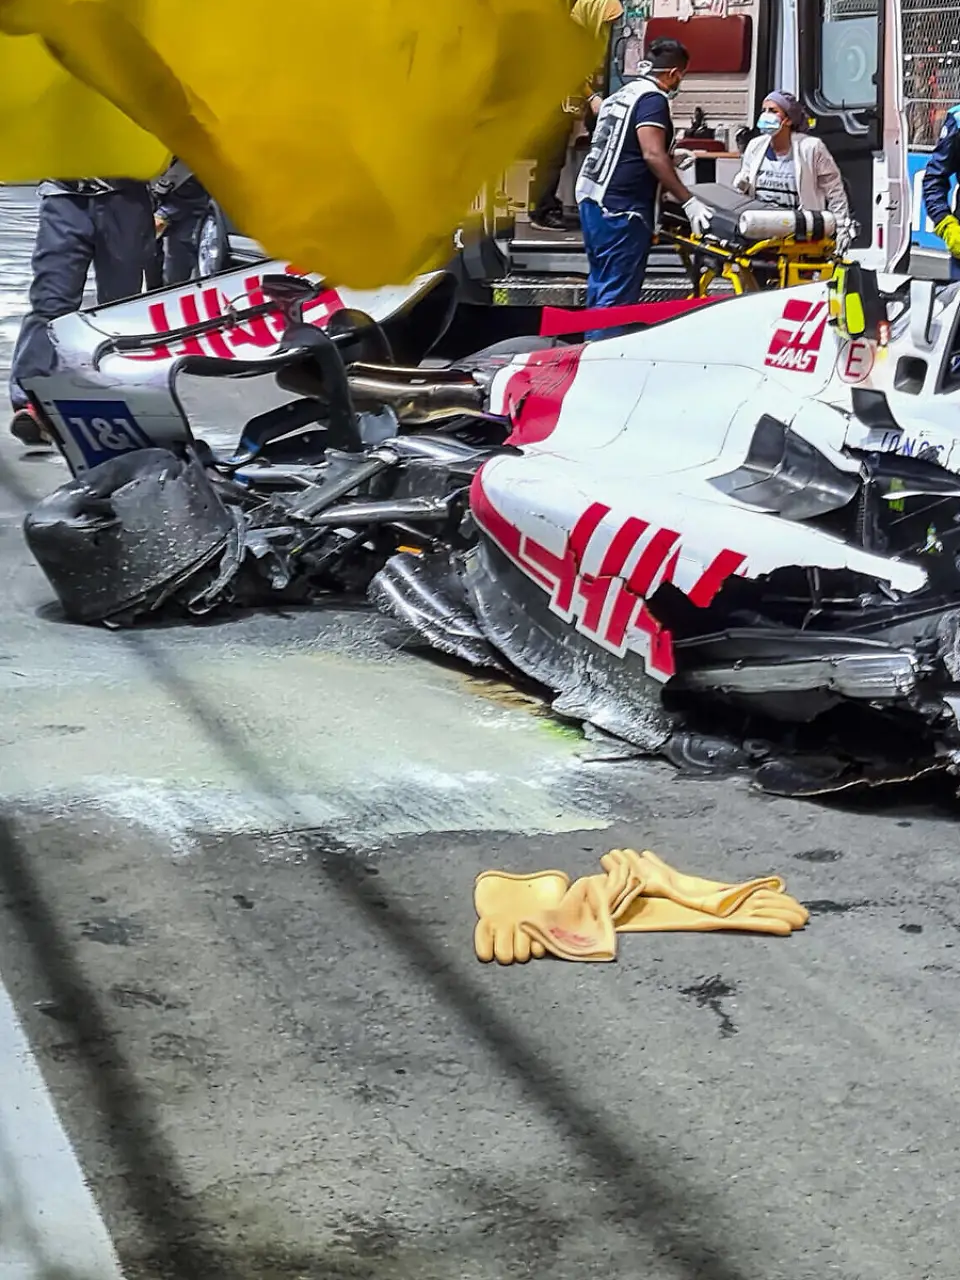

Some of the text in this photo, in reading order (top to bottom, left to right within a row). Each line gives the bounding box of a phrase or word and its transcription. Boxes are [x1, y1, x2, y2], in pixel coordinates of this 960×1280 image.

[765, 344, 820, 370] HAAS
[844, 342, 866, 377] E
[68, 417, 148, 451] 1&1
